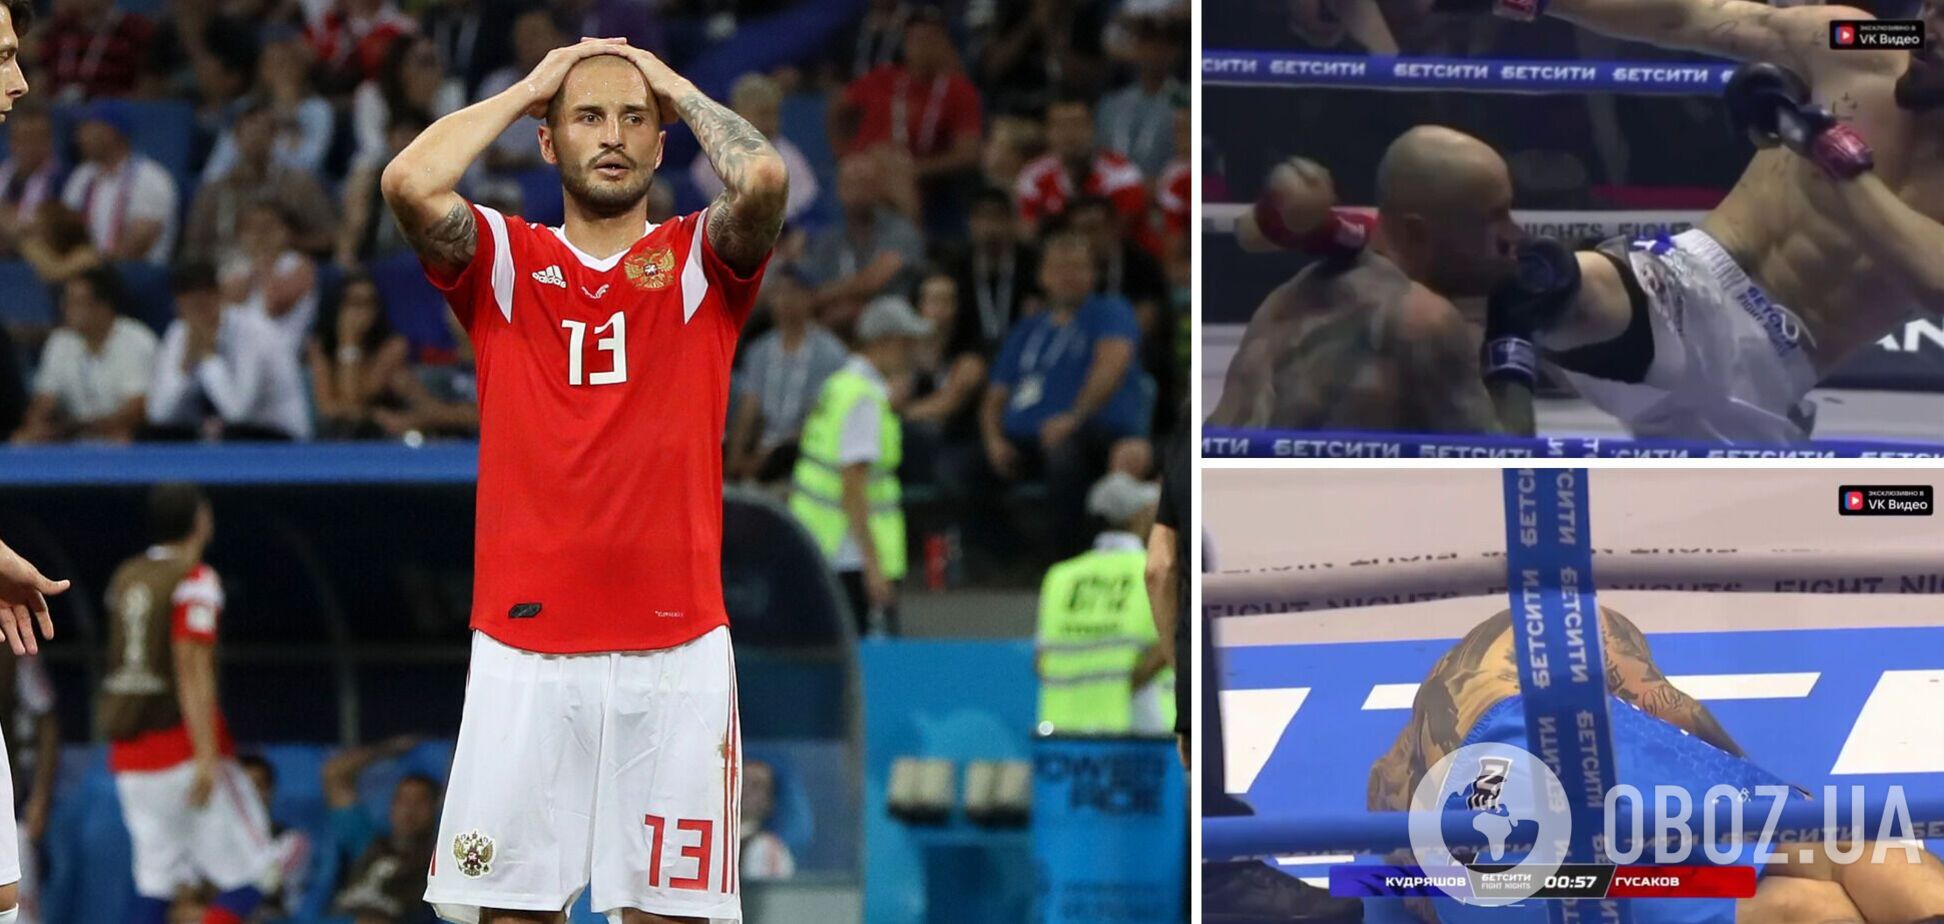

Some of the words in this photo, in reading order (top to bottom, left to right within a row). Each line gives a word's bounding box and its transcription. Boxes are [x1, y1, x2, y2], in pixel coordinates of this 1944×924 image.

[1270, 59, 1366, 76] БЕТСИТИ
[1393, 63, 1489, 79] БЕТСИТИ
[1501, 65, 1597, 81] БЕТСИТИ
[1612, 67, 1709, 83] БЕТСИТИ
[532, 271, 567, 289] adidas
[561, 310, 627, 386] 13
[1556, 468, 1577, 545] СИТИ
[1900, 574, 1944, 593] NI
[1522, 569, 1551, 690] БЕТСИТИ
[1560, 566, 1590, 684] БЕТСИТИ
[644, 814, 713, 891] 13
